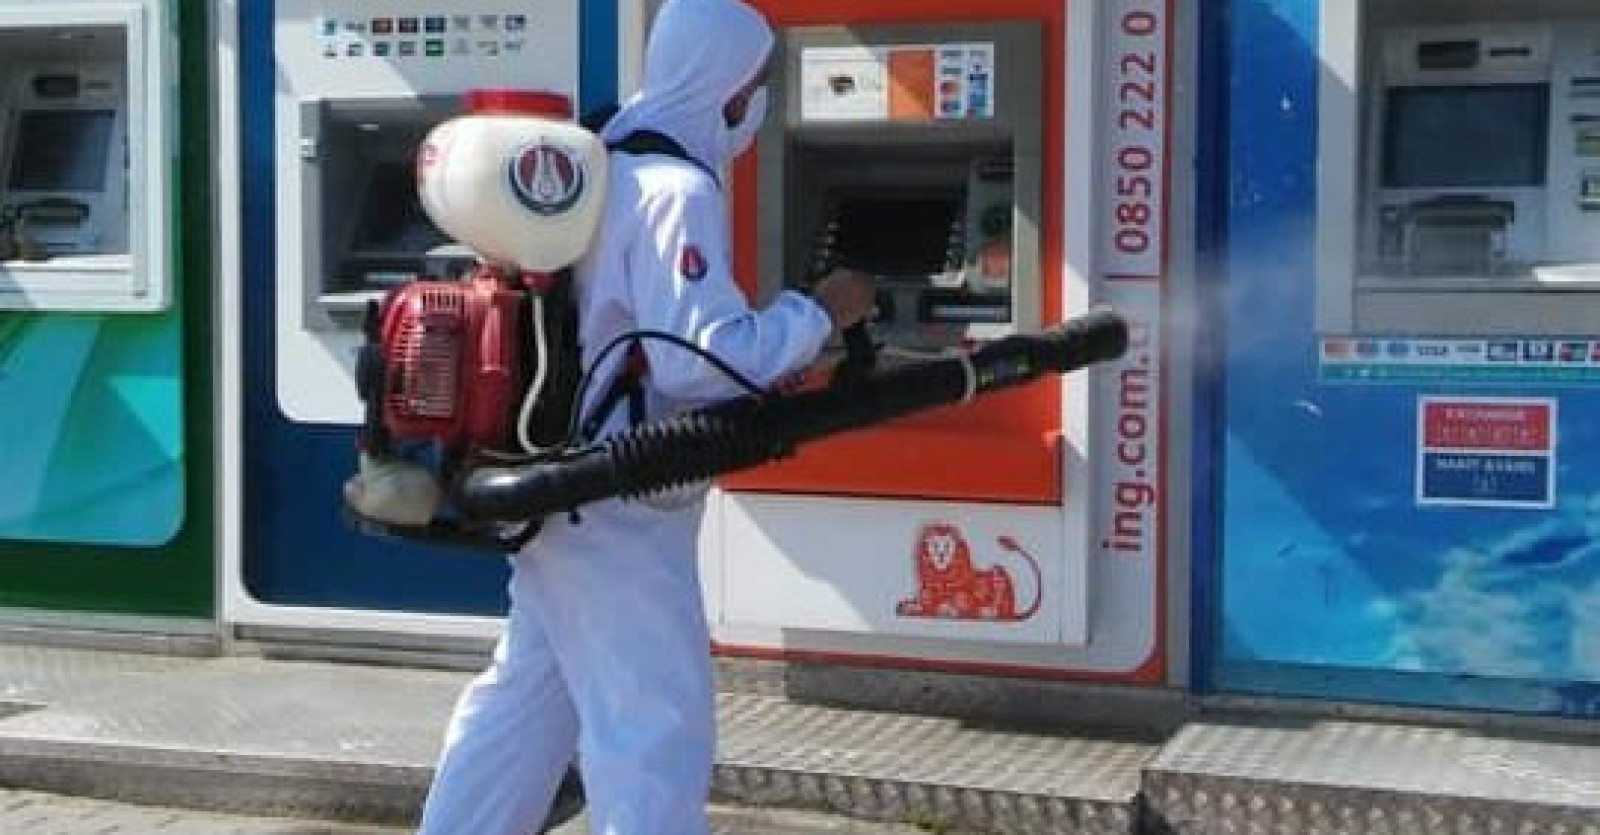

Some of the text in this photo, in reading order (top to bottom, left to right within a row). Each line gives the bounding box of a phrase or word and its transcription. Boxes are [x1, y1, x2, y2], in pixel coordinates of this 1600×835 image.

[1121, 11, 1157, 36] 0
[1119, 53, 1156, 130] 222
[1115, 148, 1152, 253] 0850
